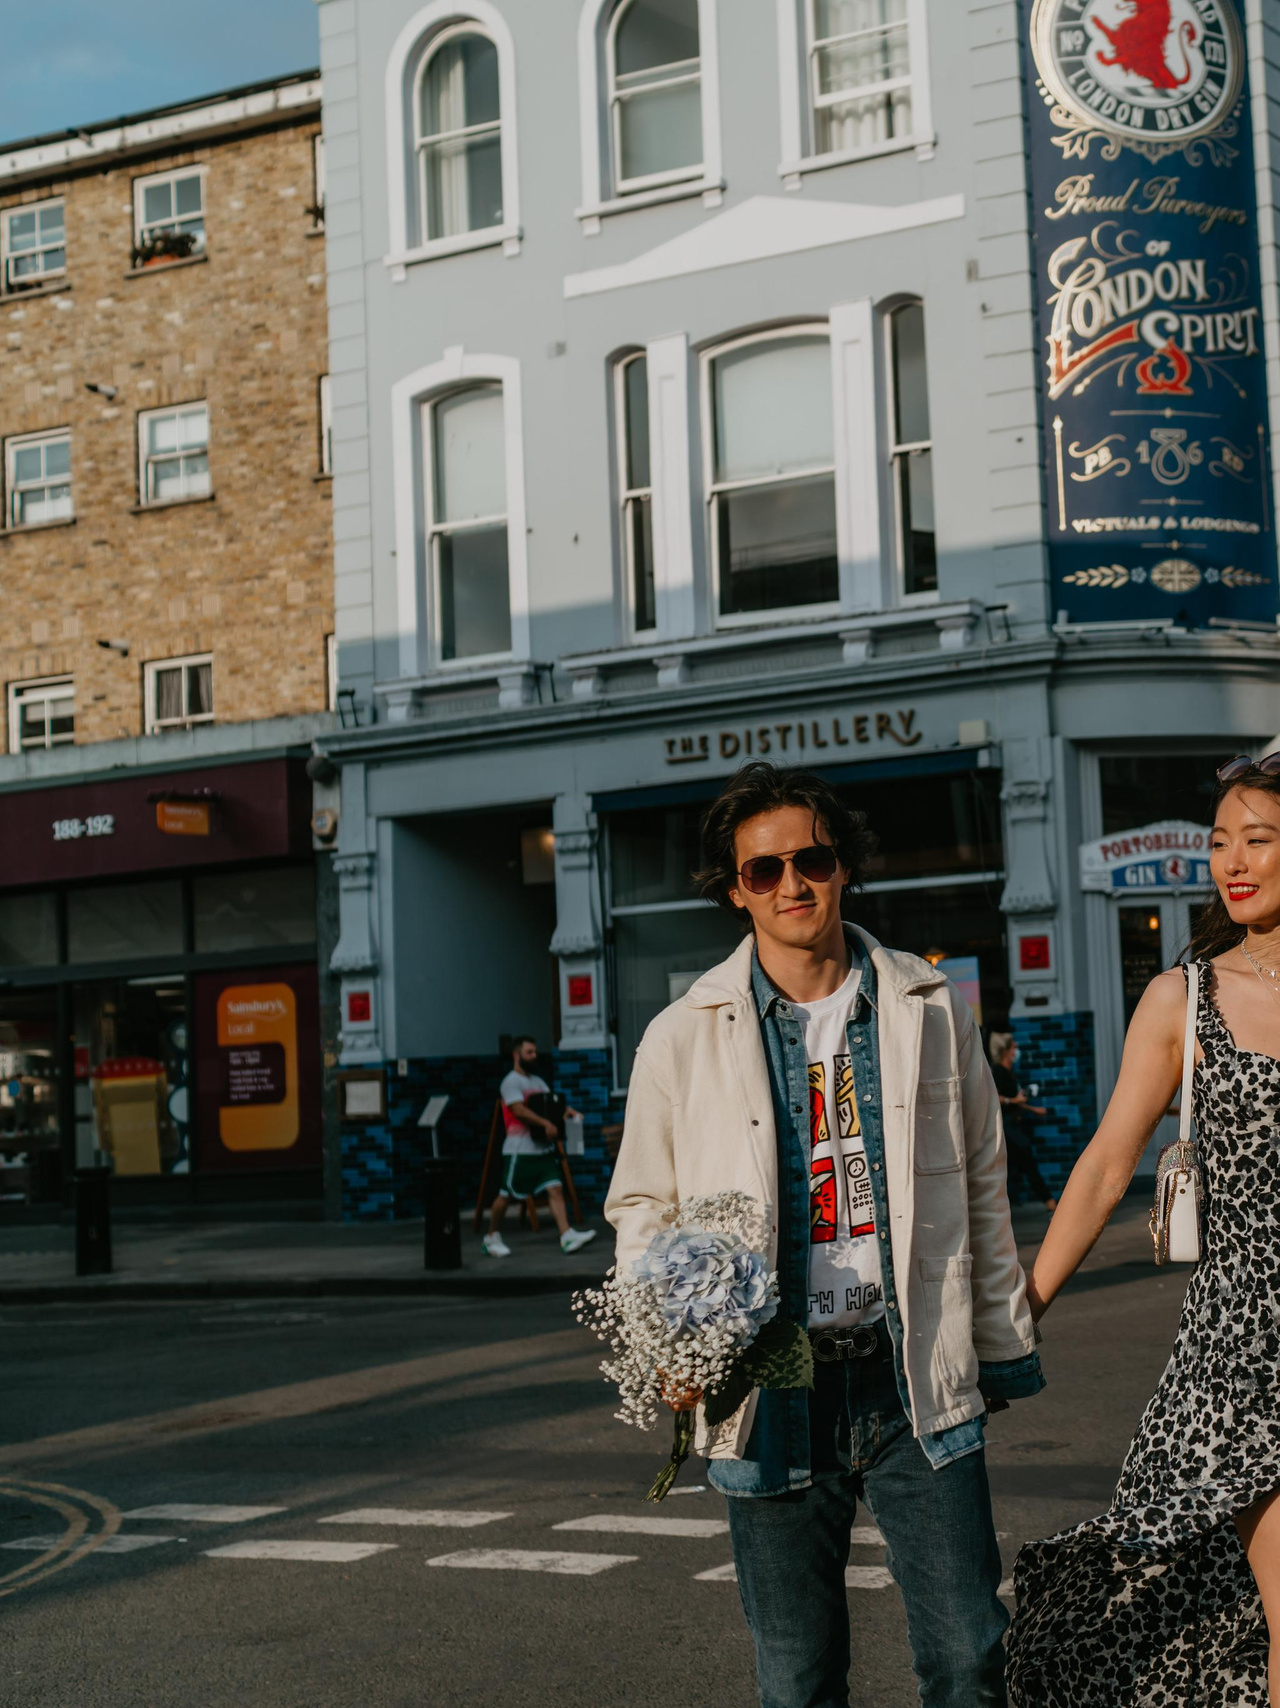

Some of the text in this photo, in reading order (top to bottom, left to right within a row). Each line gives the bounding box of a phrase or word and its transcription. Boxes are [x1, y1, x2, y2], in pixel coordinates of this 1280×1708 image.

[1068, 69, 1222, 131] LONDON DRY GIN
[1044, 173, 1140, 220] Proud
[1144, 240, 1171, 256] OF
[1046, 236, 1210, 385] LONDON
[1141, 308, 1258, 368] SPIRIT
[1084, 446, 1113, 475] PB
[1071, 516, 1261, 534] VICTUALS & LODGINGS
[664, 708, 922, 758] THE DISTILLERY
[52, 814, 115, 840] 188-192
[1100, 831, 1204, 861] PORTOBELLO
[1124, 864, 1156, 885] GIN
